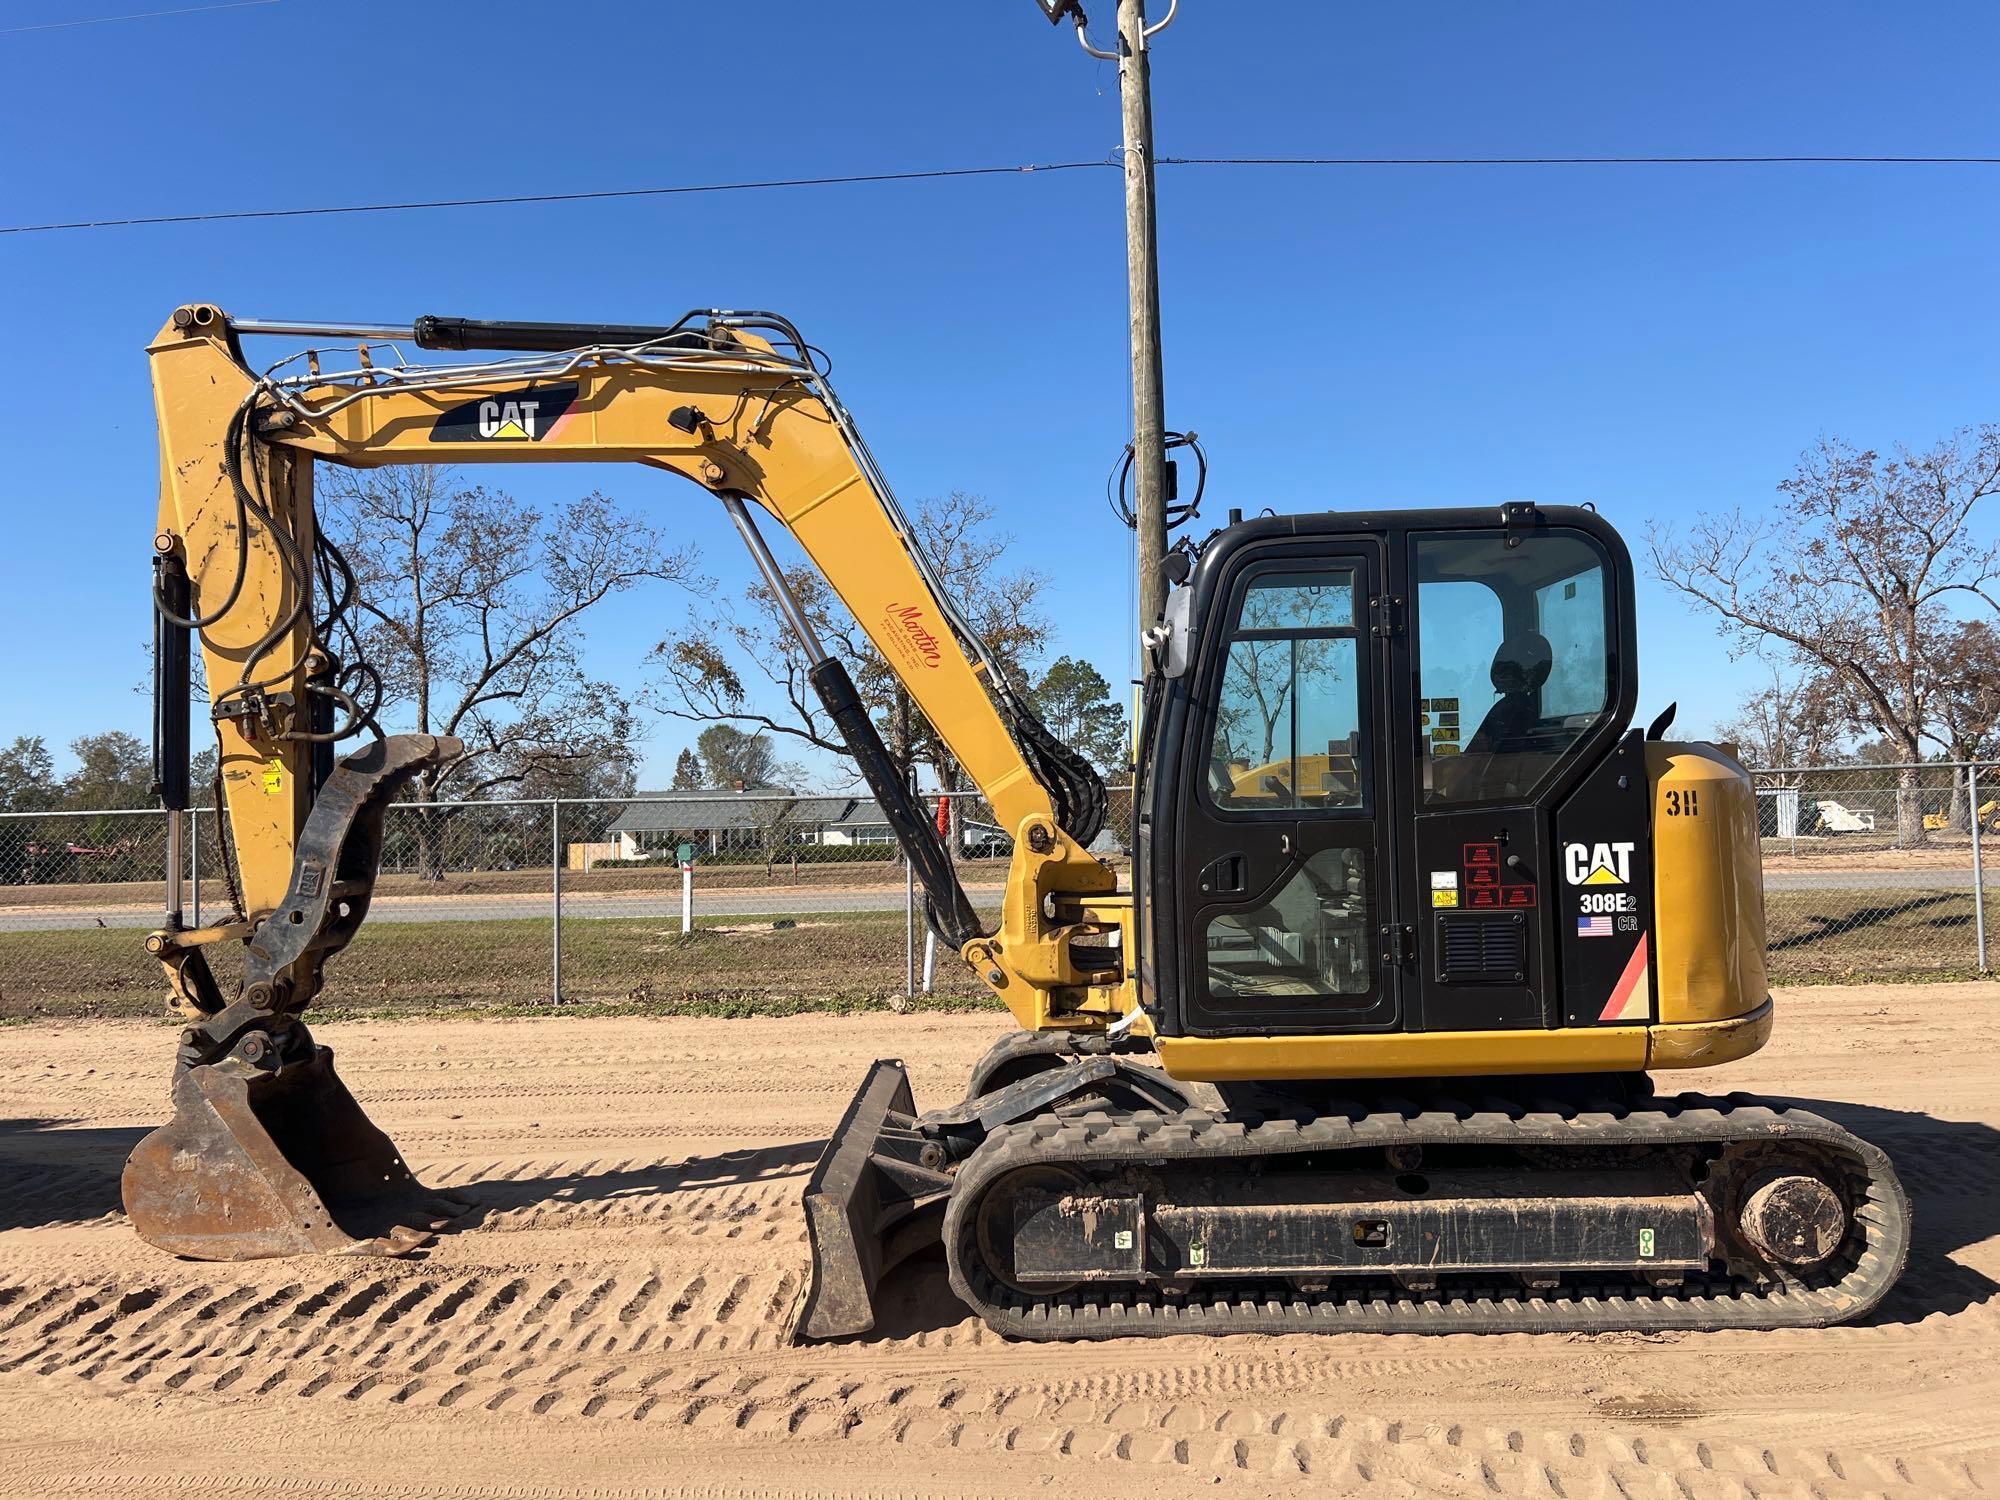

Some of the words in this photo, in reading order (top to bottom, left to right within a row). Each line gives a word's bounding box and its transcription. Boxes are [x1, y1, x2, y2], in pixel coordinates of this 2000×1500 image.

[479, 401, 540, 438] CAT
[886, 602, 941, 668] Martin
[1565, 842, 1634, 886] CAT
[1580, 893, 1637, 914] 308E2
[1617, 916, 1638, 931] CR
